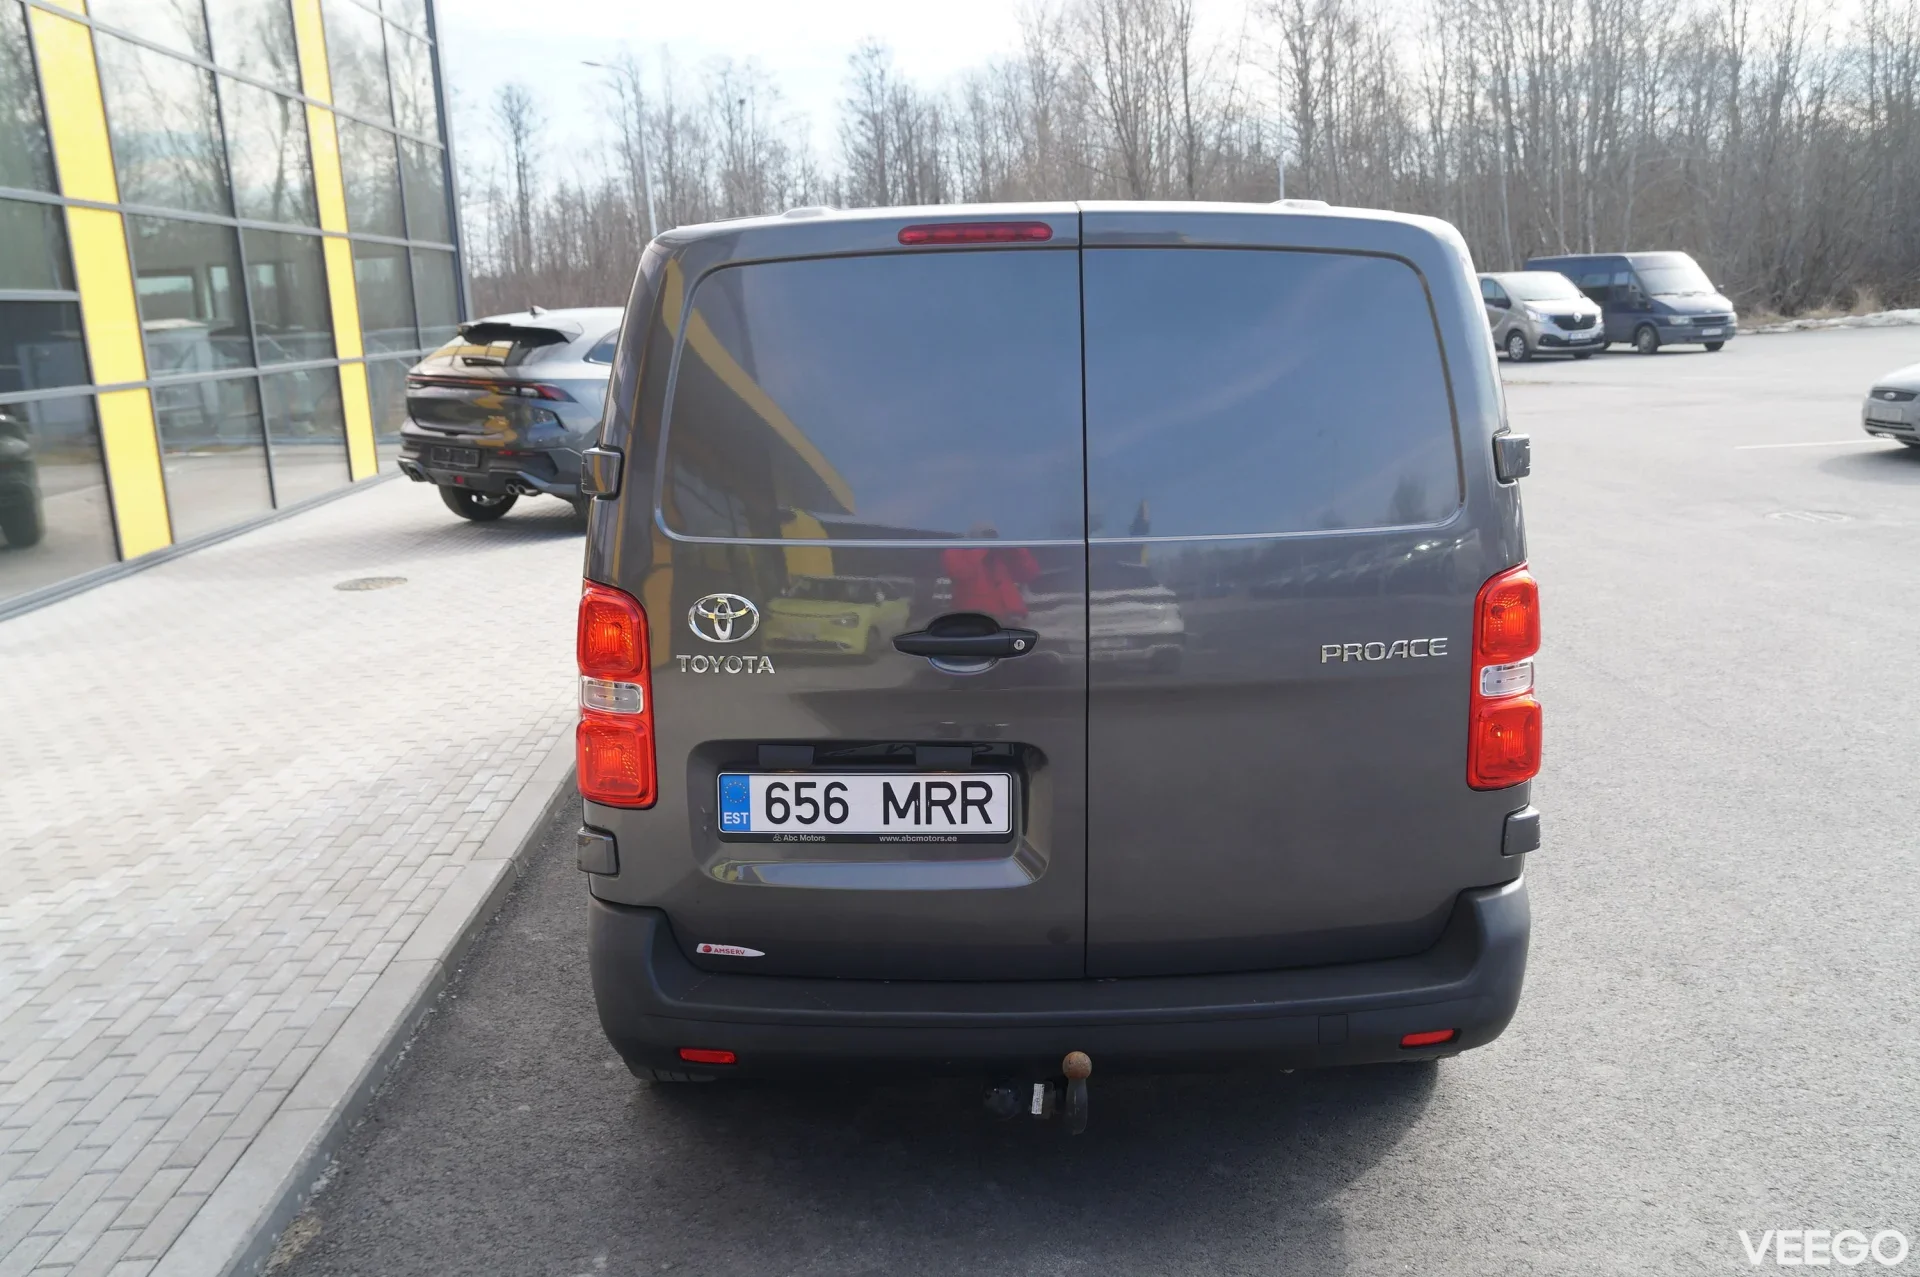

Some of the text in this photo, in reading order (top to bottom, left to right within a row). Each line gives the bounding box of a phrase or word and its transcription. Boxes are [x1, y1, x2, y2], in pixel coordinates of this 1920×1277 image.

[1321, 637, 1448, 663] PROACE
[676, 655, 775, 674] TOYOTA
[765, 781, 993, 825] 656 MRR
[723, 812, 749, 824] EST
[783, 834, 826, 842] Abc Motors
